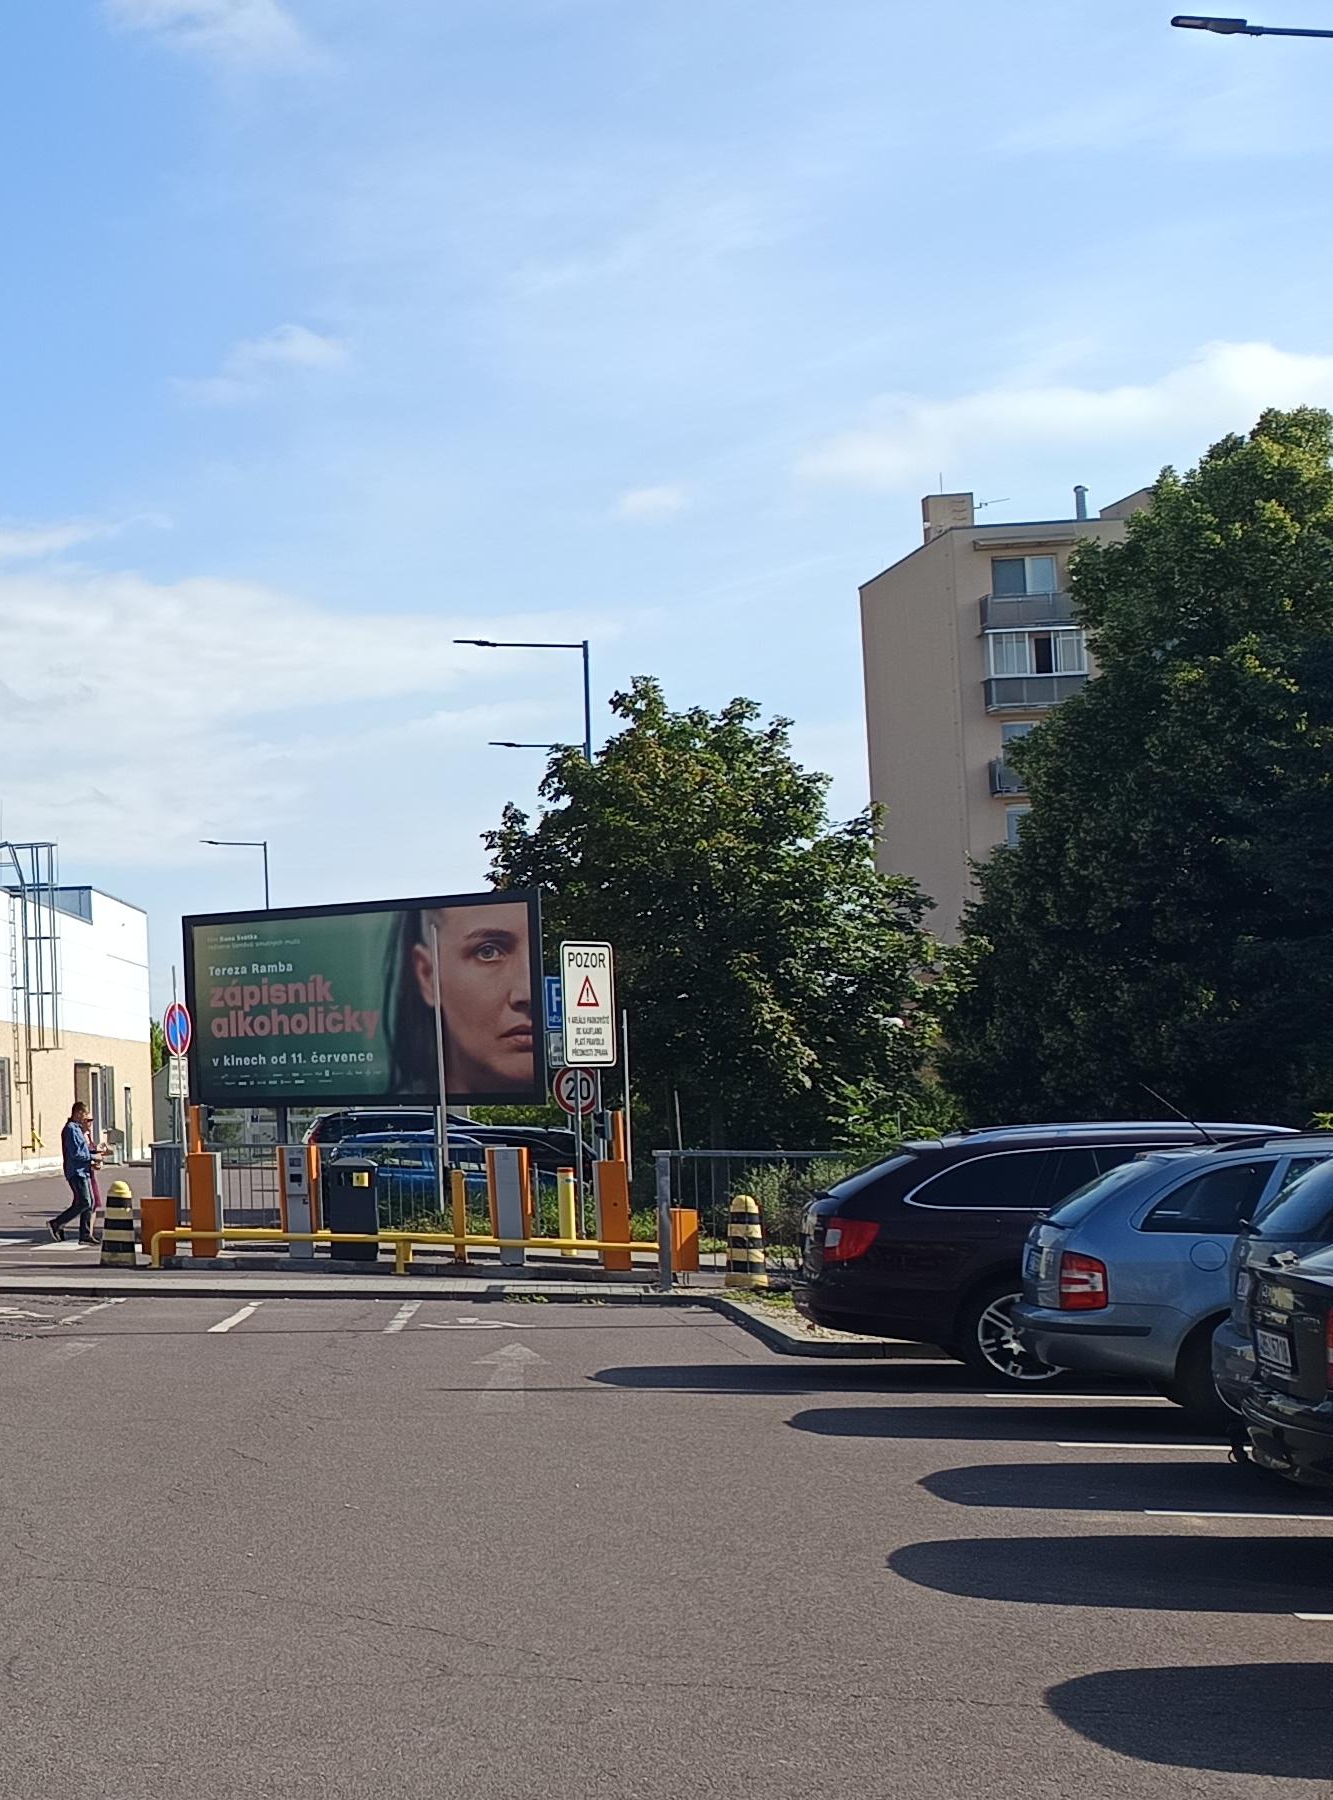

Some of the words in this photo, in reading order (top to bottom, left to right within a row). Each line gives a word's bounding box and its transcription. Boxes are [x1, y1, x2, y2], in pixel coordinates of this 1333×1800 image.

[209, 965, 248, 976] Tereza
[251, 961, 293, 974] Ramba
[568, 952, 606, 968] POZOR
[210, 974, 334, 1010] zápisník
[211, 1004, 380, 1040] alkoholičky
[212, 1058, 219, 1066] v
[223, 1053, 266, 1067] kinech
[271, 1053, 287, 1065] od
[291, 1053, 307, 1064] 11.
[311, 1051, 374, 1064] července
[564, 1077, 591, 1101] 20
